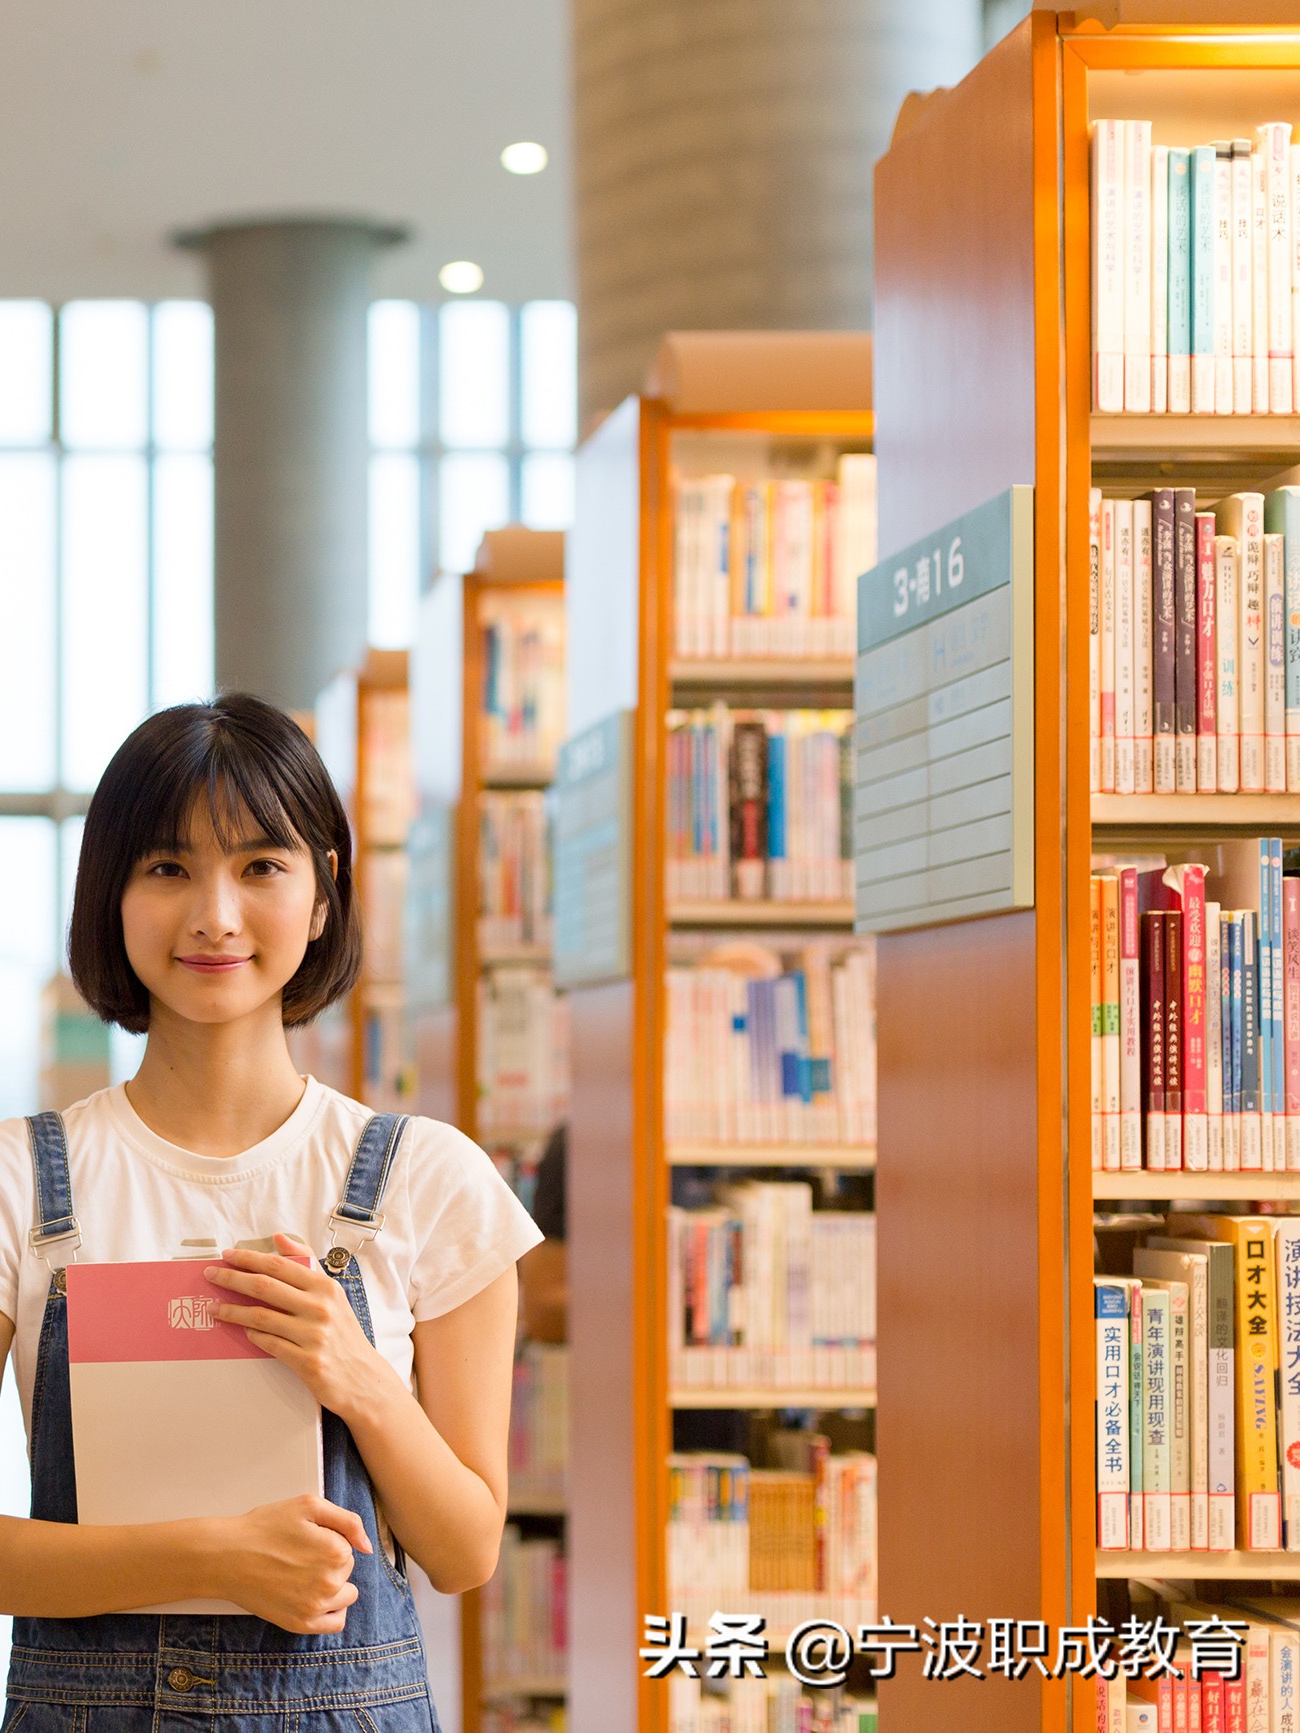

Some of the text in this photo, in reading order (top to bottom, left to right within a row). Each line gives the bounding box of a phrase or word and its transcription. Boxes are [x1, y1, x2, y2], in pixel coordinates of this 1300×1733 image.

[1201, 562, 1215, 637] 魅力口才
[1105, 906, 1117, 974] 演讲与口才
[1287, 928, 1300, 980] 谈笑风生
[1246, 1240, 1267, 1336] 口才大全
[1147, 1309, 1165, 1446] 青年演讲现用现查
[1215, 1297, 1229, 1387] 翻译的文化回归
[1104, 1326, 1123, 1474] 实用口才必备全书
